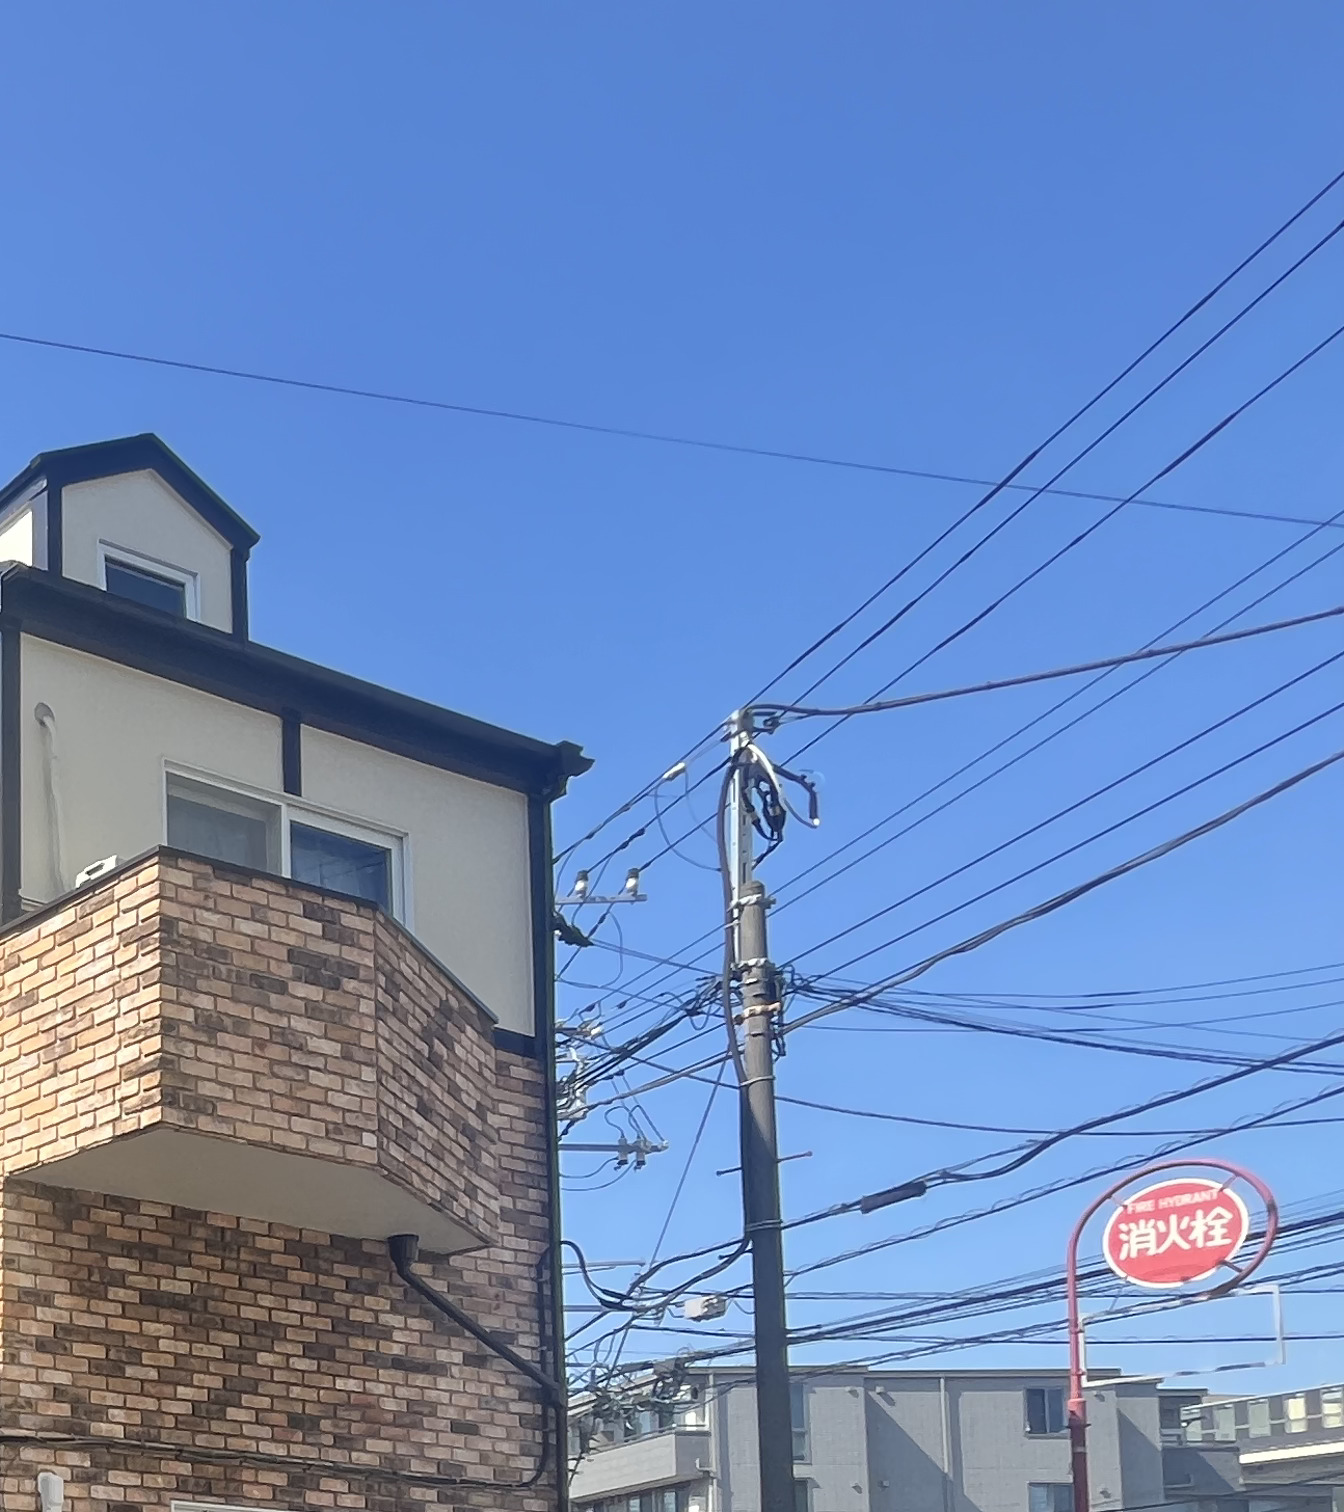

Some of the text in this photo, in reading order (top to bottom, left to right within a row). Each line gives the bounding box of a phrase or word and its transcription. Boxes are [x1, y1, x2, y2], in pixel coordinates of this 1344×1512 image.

[1127, 1188, 1218, 1214] FIRE HYDRANT
[1118, 1206, 1233, 1260] 消火栓
